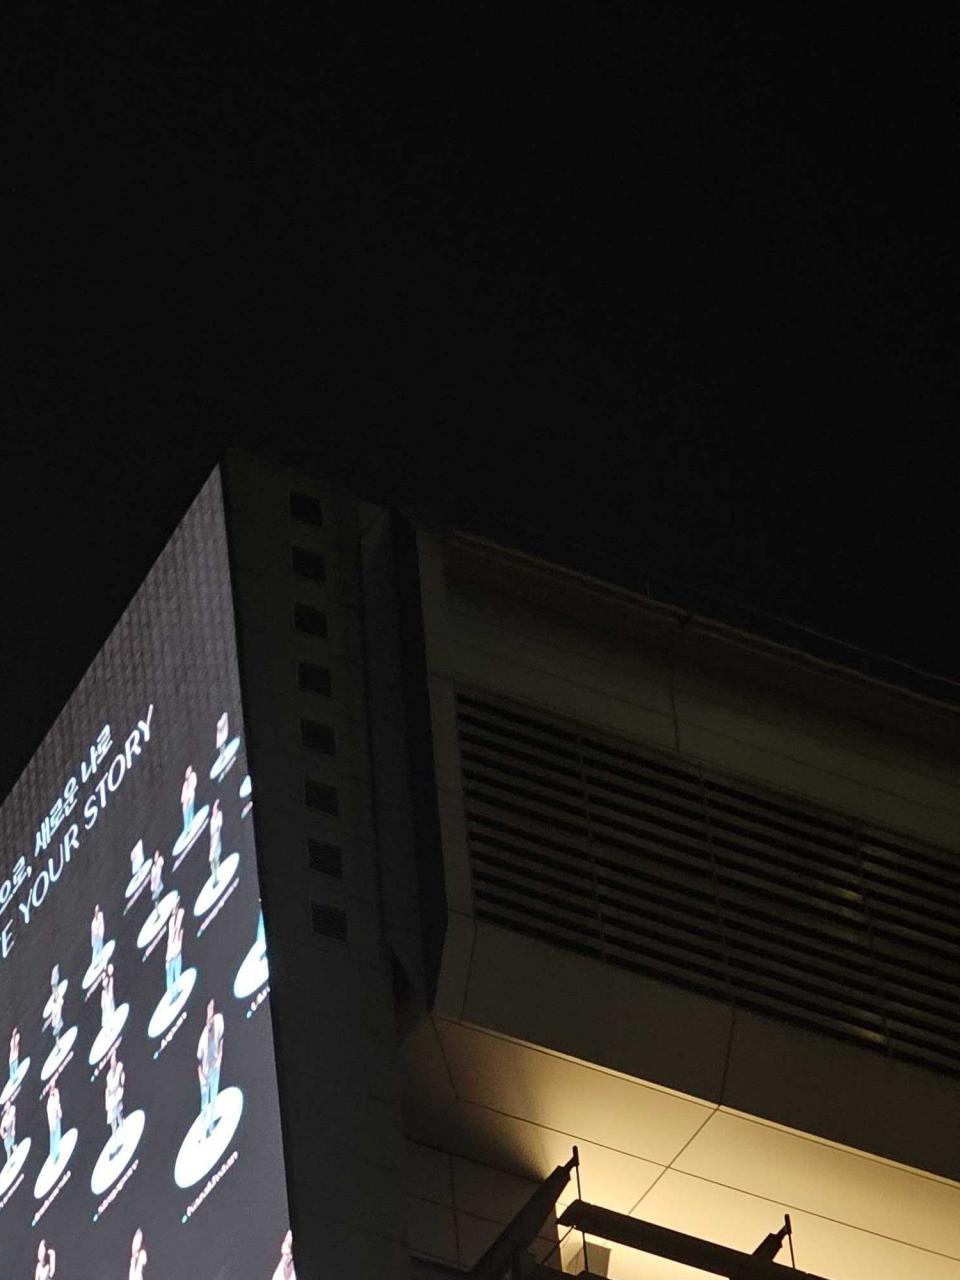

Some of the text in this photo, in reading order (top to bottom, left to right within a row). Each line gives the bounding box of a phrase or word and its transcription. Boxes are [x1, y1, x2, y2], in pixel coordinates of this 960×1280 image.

[18, 824, 80, 926] YOUR
[83, 703, 154, 830] STORY
[34, 776, 79, 858] 새로운
[80, 724, 114, 784] 나로
